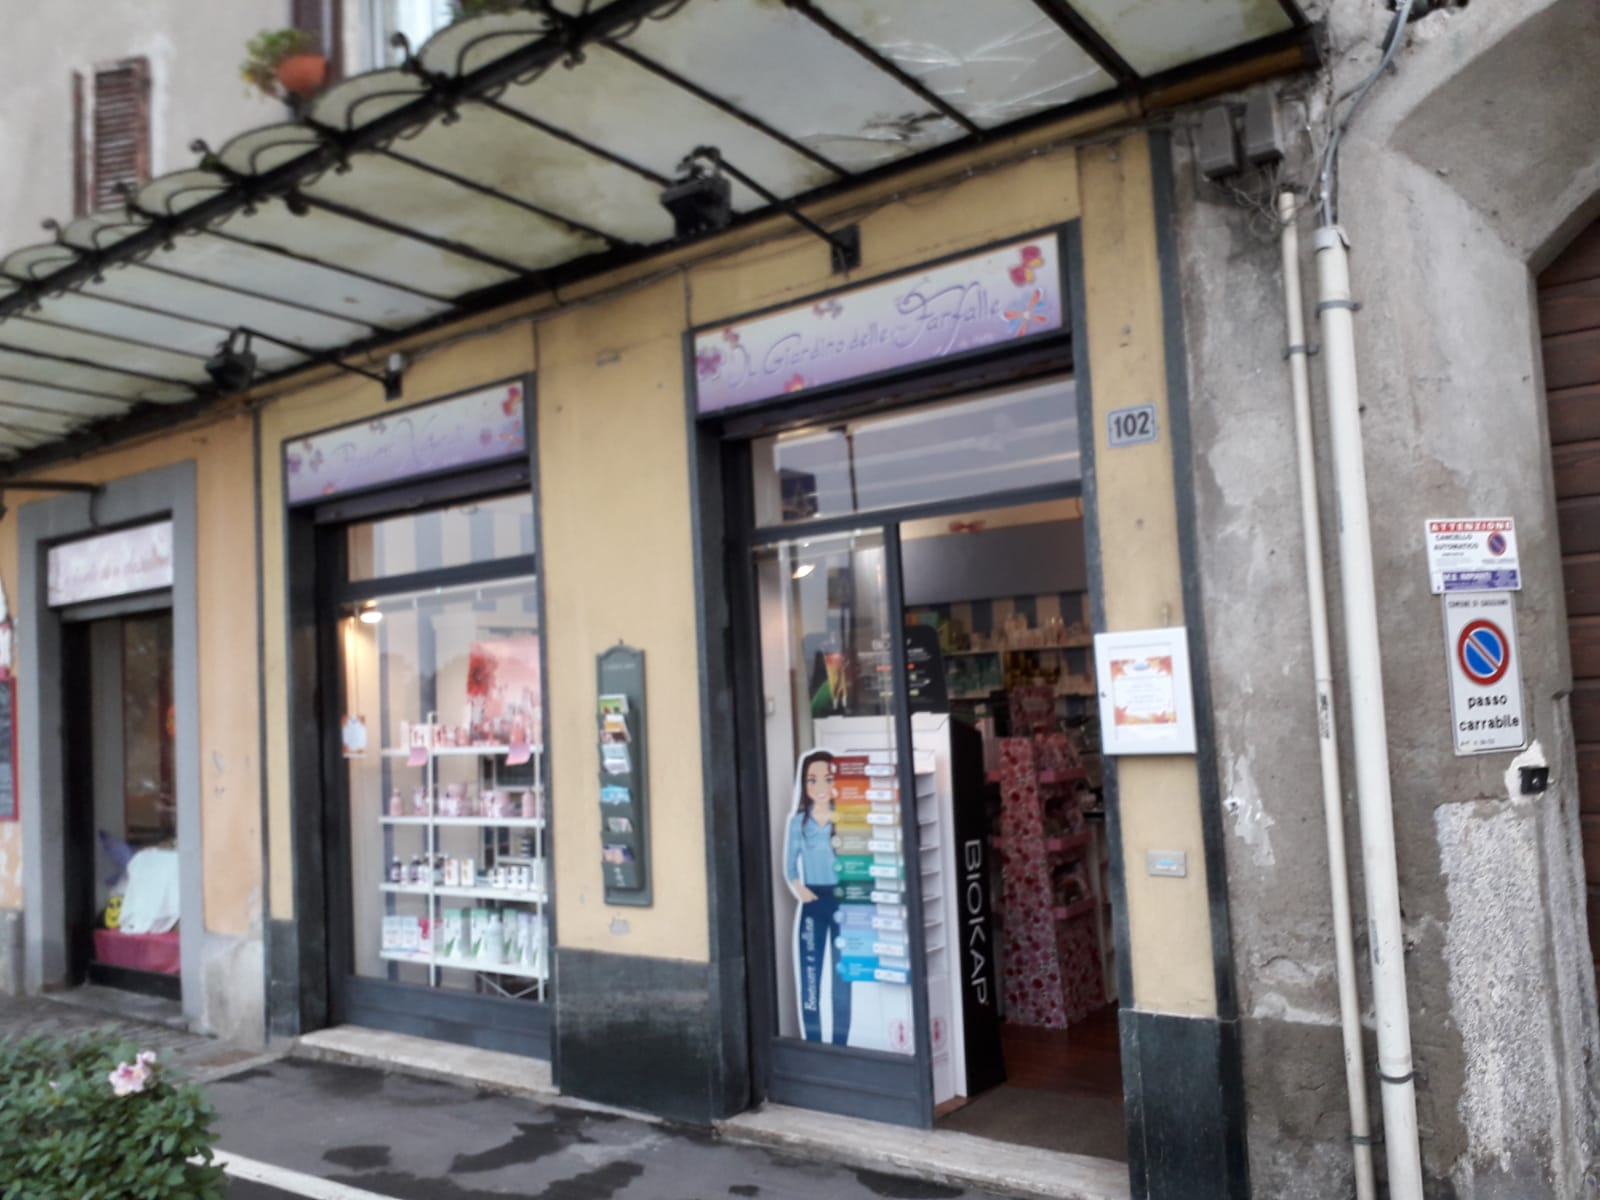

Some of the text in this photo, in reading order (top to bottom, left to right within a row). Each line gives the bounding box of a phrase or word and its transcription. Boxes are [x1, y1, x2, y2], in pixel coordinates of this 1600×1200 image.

[763, 333, 846, 374] Giardino
[849, 323, 889, 351] delle
[893, 280, 1000, 355] Farfalle
[1114, 410, 1150, 439] 102
[1430, 520, 1512, 533] ATTENZIONE
[1434, 543, 1479, 551] AUTOMATICO
[1468, 694, 1508, 710] passo
[1459, 714, 1520, 732] carrabile
[964, 839, 988, 1005] BIOKAP
